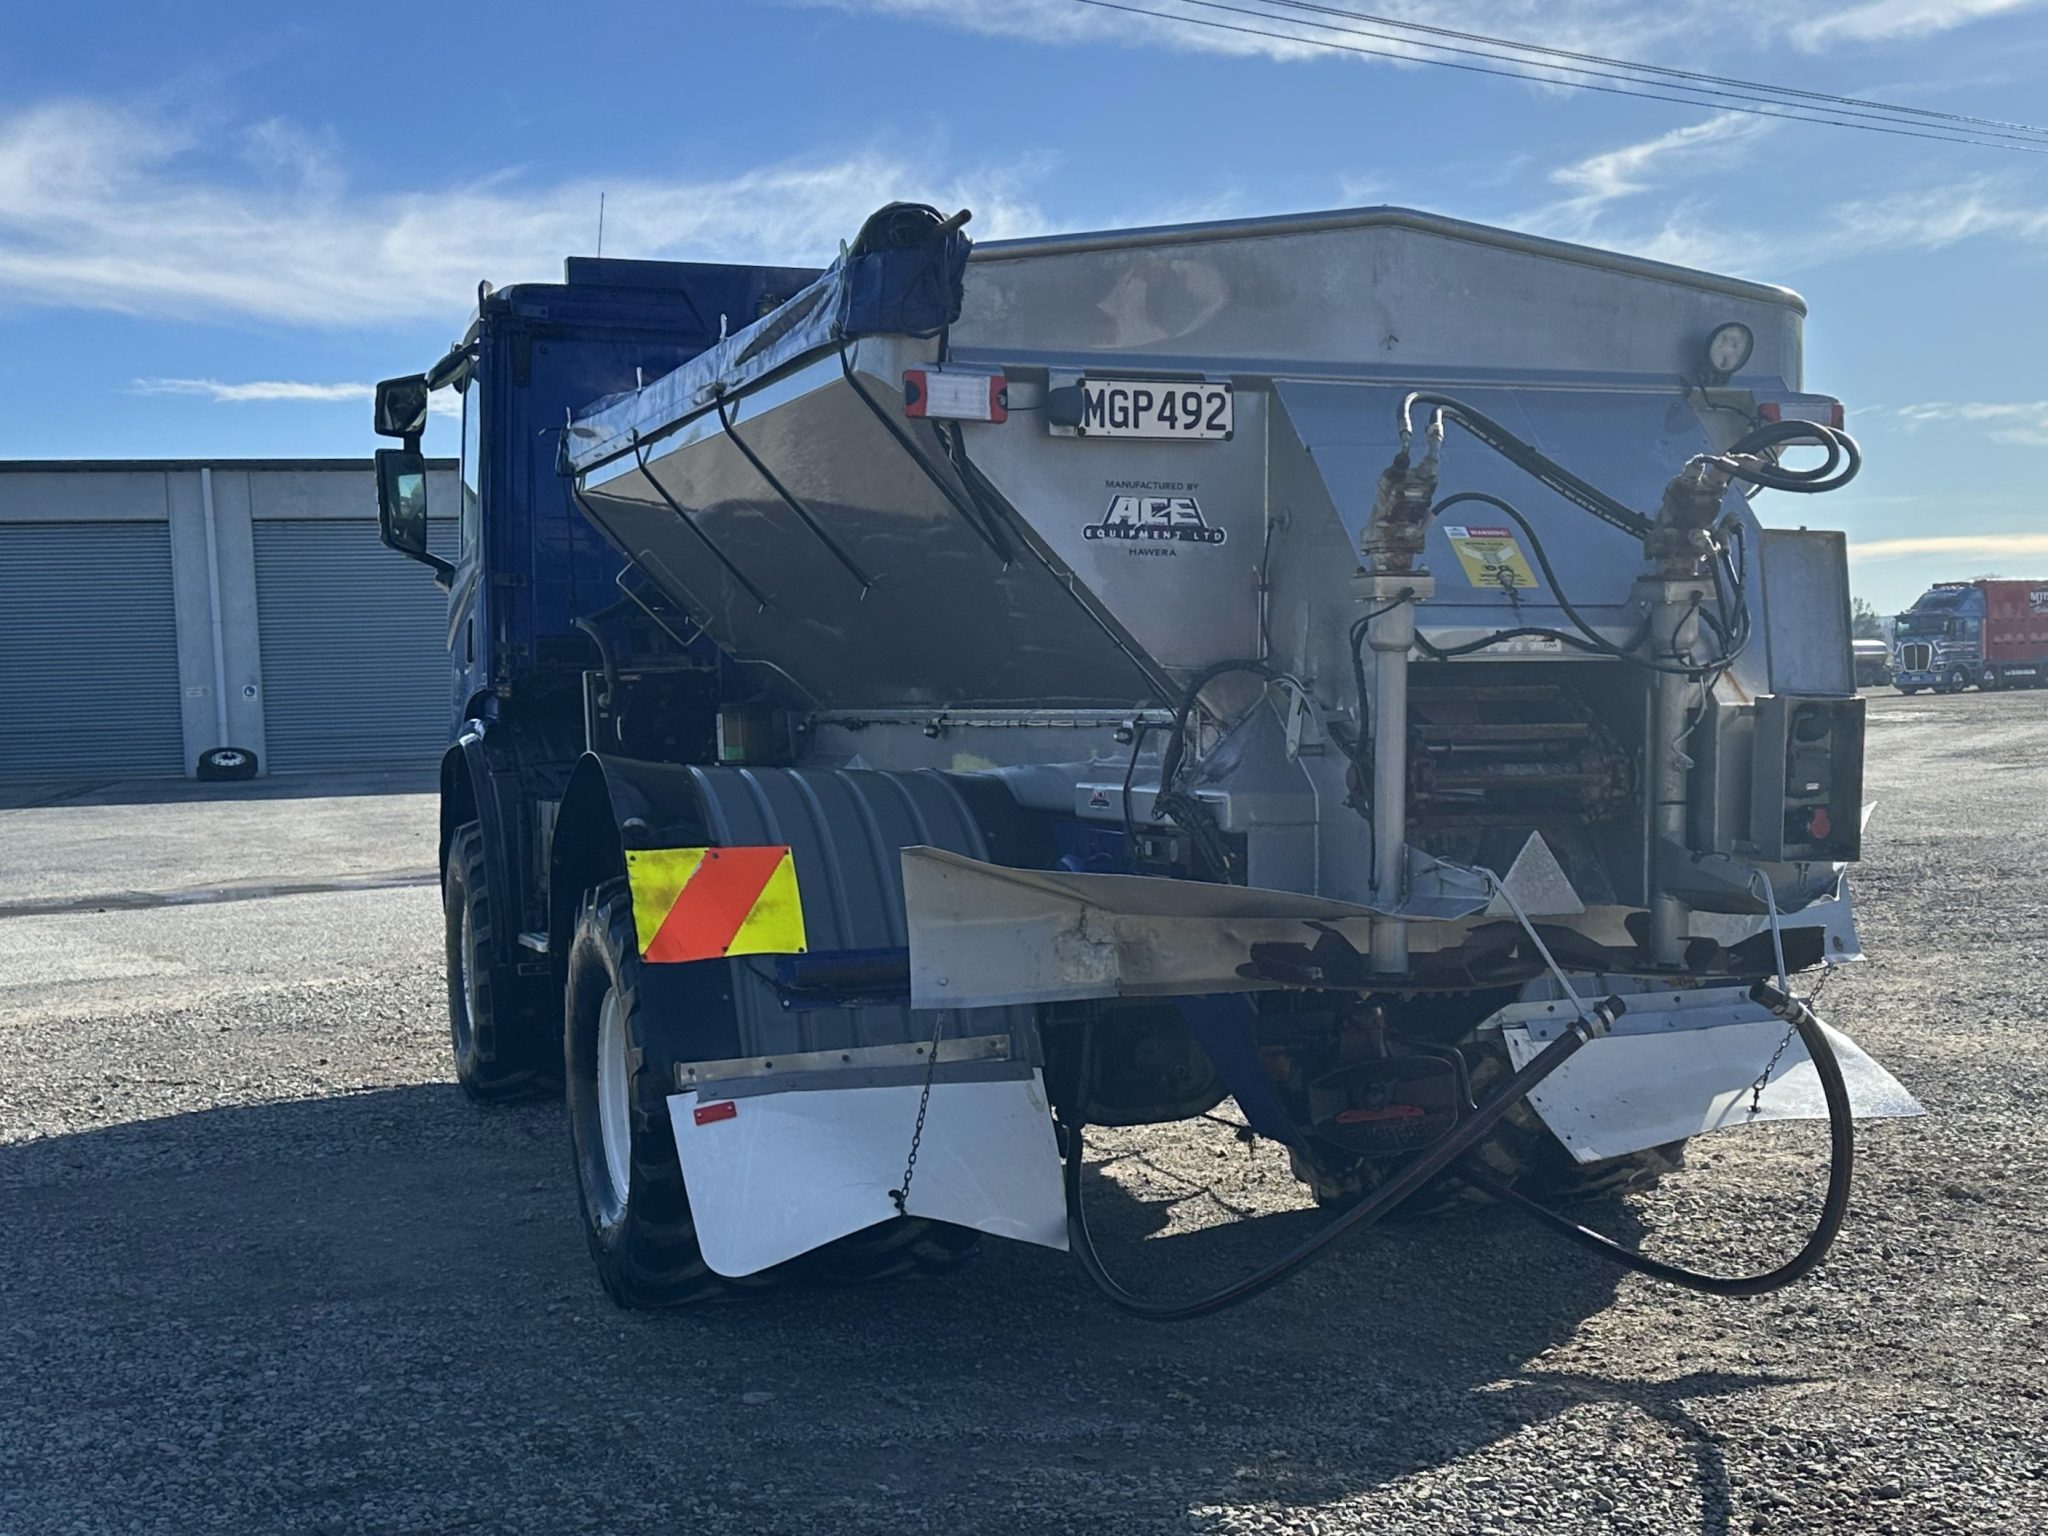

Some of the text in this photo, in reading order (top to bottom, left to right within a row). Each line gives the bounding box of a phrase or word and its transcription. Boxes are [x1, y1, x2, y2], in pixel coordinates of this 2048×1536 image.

[1084, 388, 1227, 432] MGP492
[1105, 480, 1200, 491] MANUFACTURED BY
[1107, 496, 1202, 526] ACE
[1085, 528, 1222, 541] EQUIPMENT LTD
[1128, 548, 1177, 557] HAWERA
